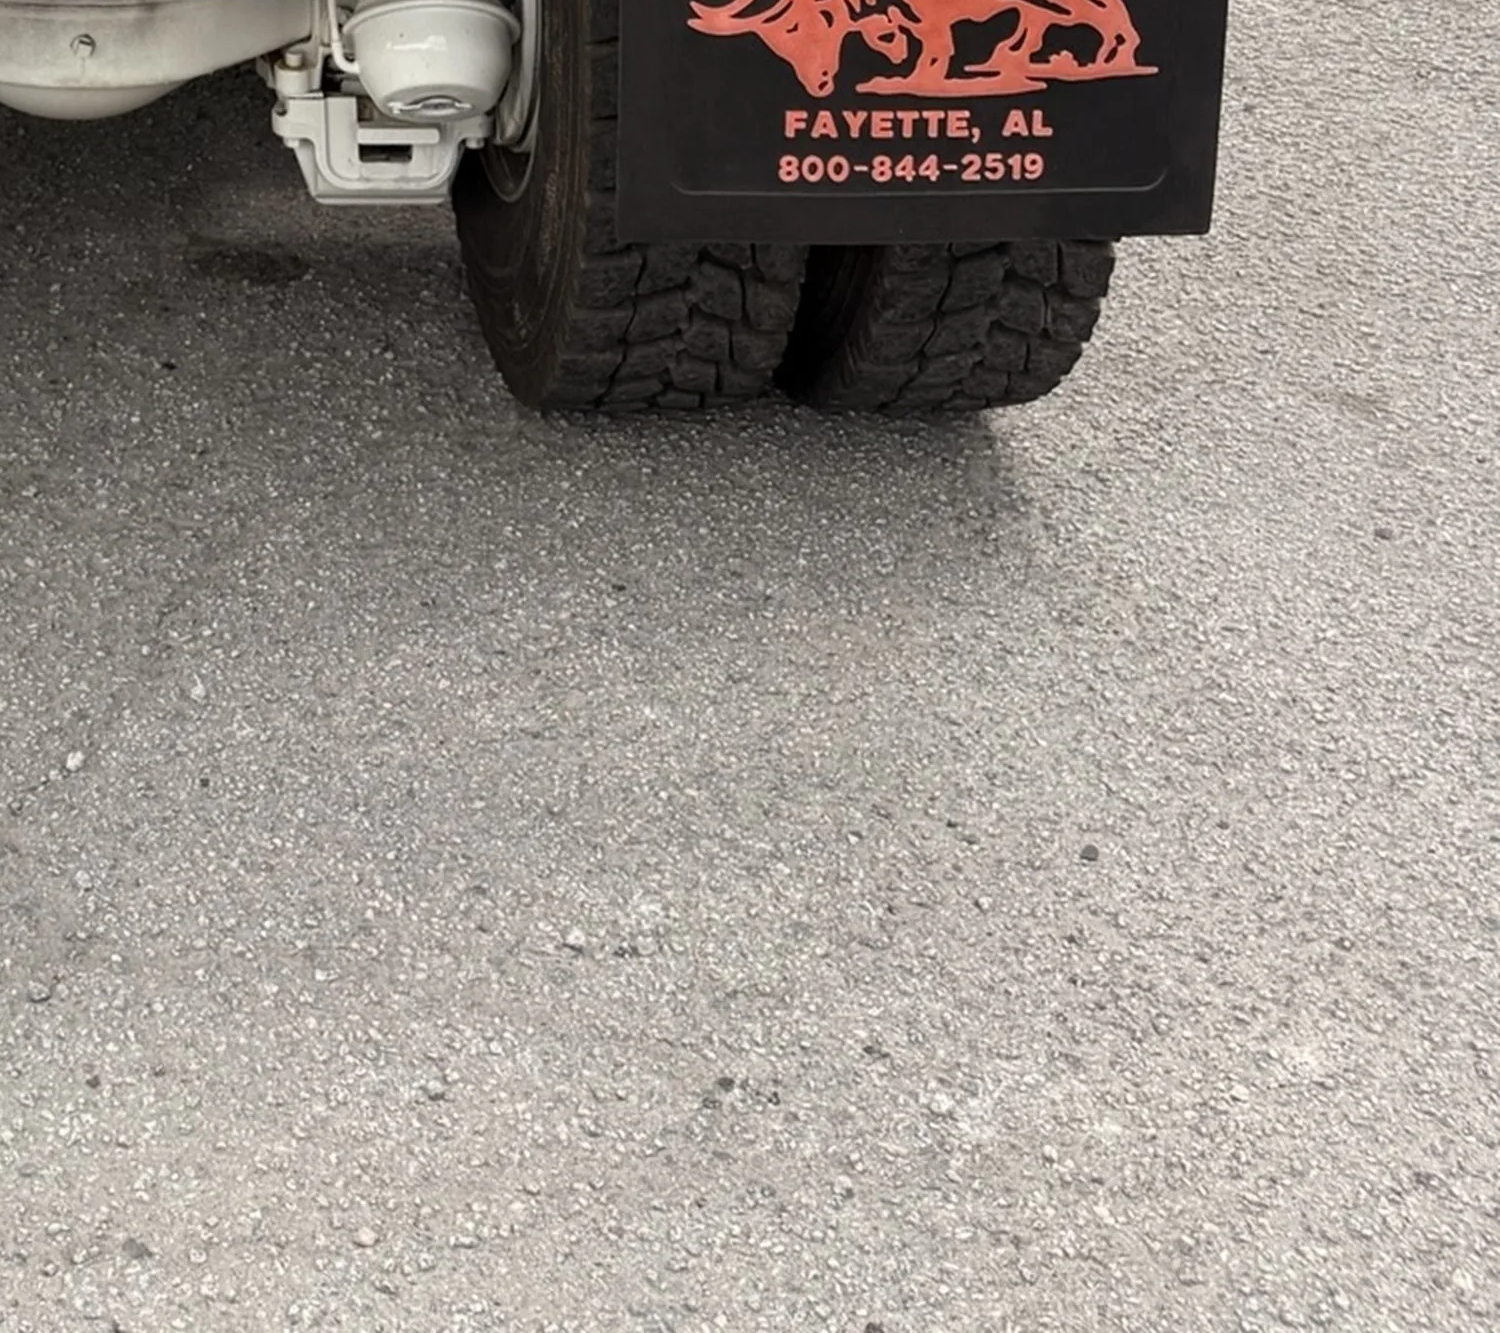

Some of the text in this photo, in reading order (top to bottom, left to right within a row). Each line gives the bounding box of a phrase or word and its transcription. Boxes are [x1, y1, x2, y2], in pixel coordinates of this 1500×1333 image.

[784, 109, 1054, 143] FAYETTE, AL
[777, 152, 1044, 184] 800-844-2519
